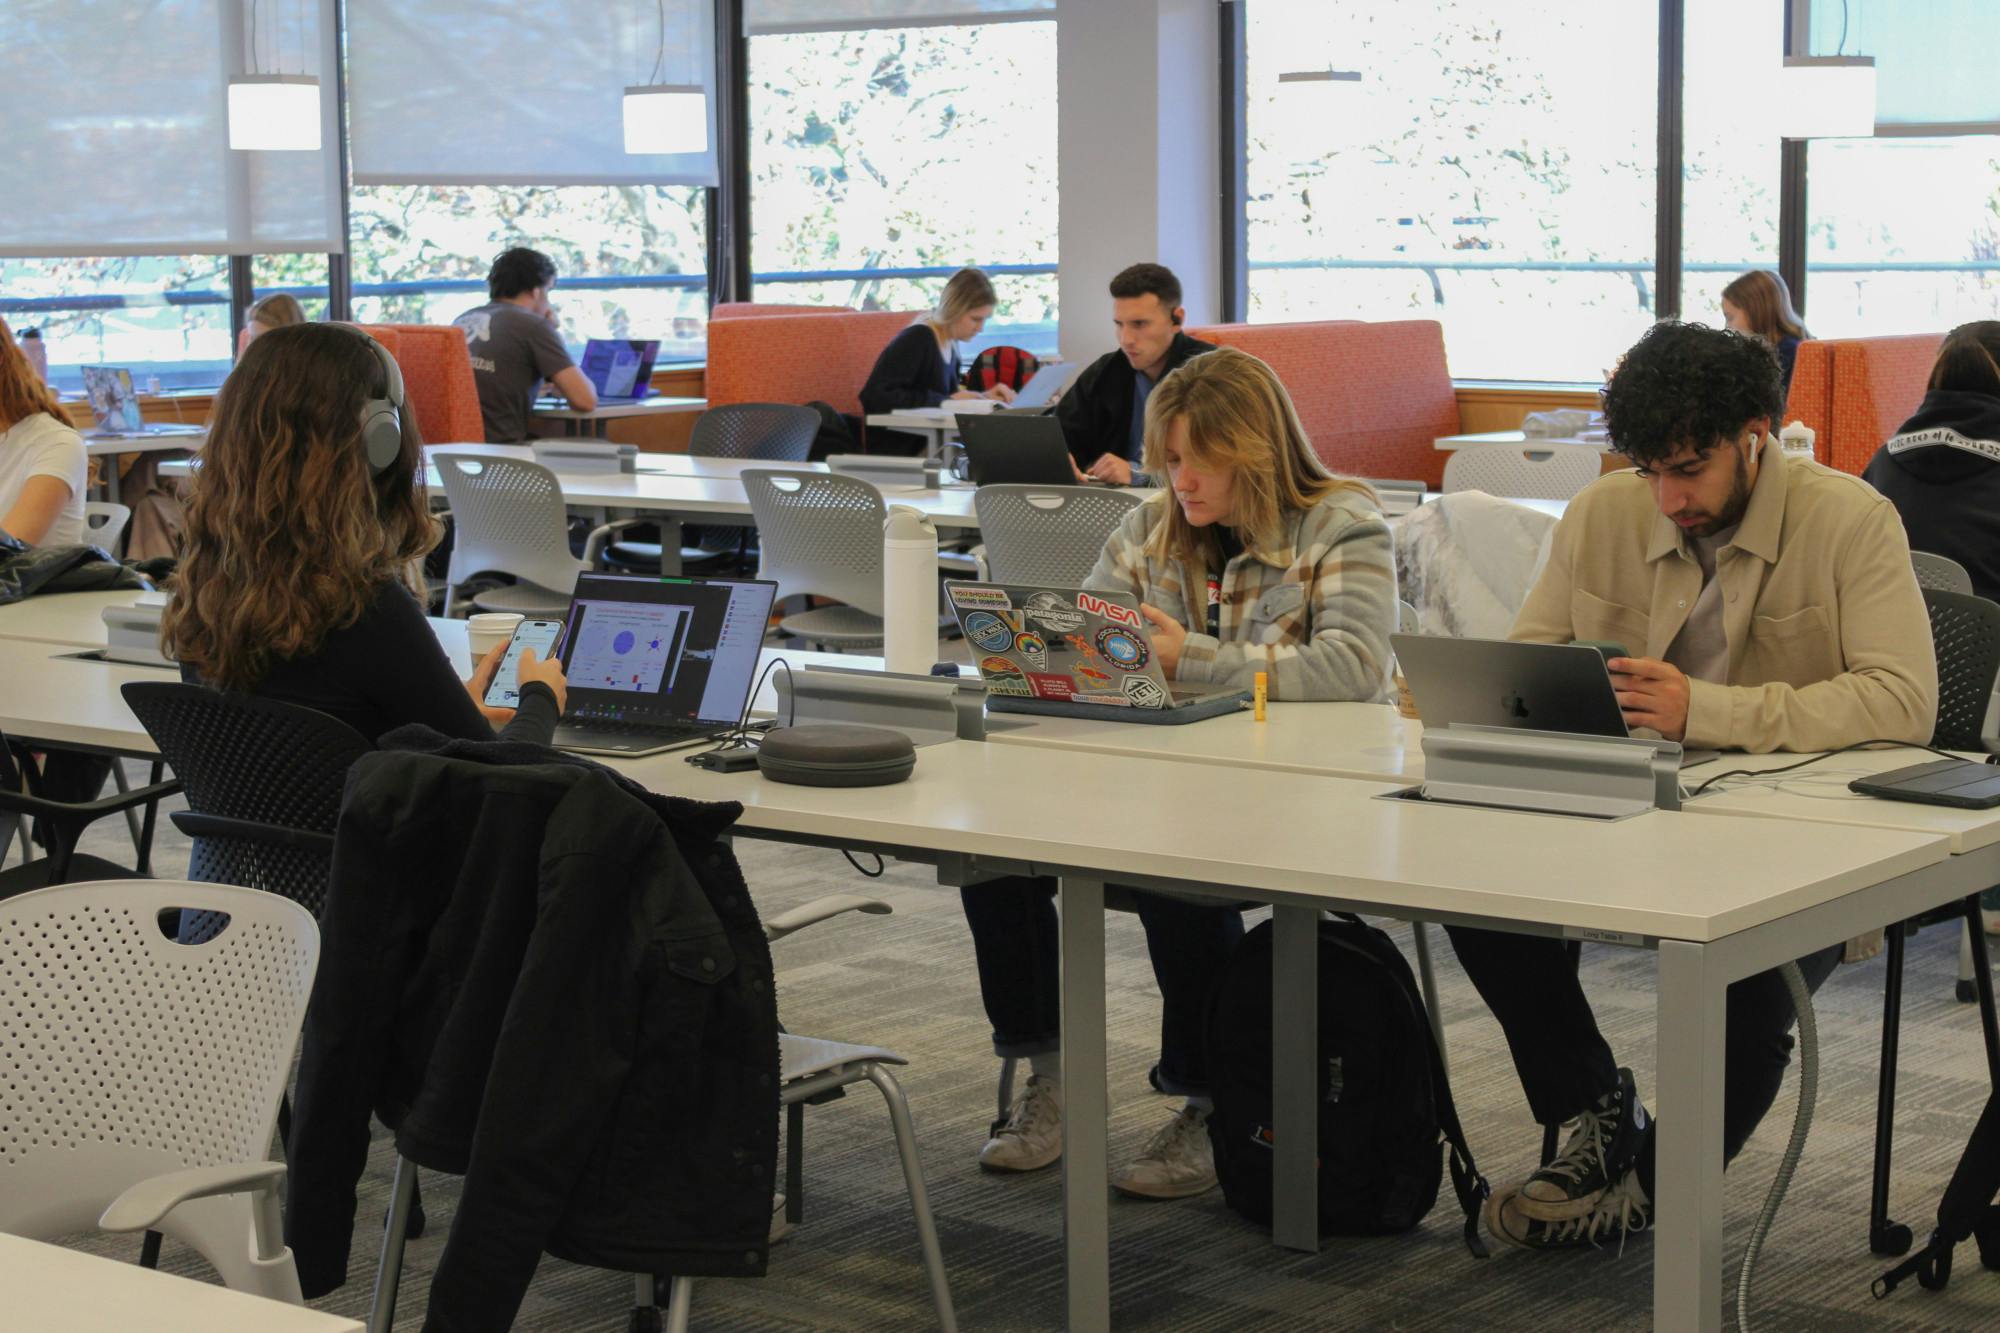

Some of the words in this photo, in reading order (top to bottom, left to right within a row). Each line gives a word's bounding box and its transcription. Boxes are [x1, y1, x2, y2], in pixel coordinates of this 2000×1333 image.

[1026, 609, 1083, 622] patagonia
[1079, 593, 1140, 626] NASA
[986, 623, 1004, 635] WAX
[1098, 628, 1121, 640] COCOA
[1123, 631, 1147, 654] BEACH
[1104, 654, 1141, 670] FLORIDA
[989, 687, 1031, 696] ASHEVILLE
[1130, 683, 1156, 700] YETI
[1584, 930, 1599, 939] Long
